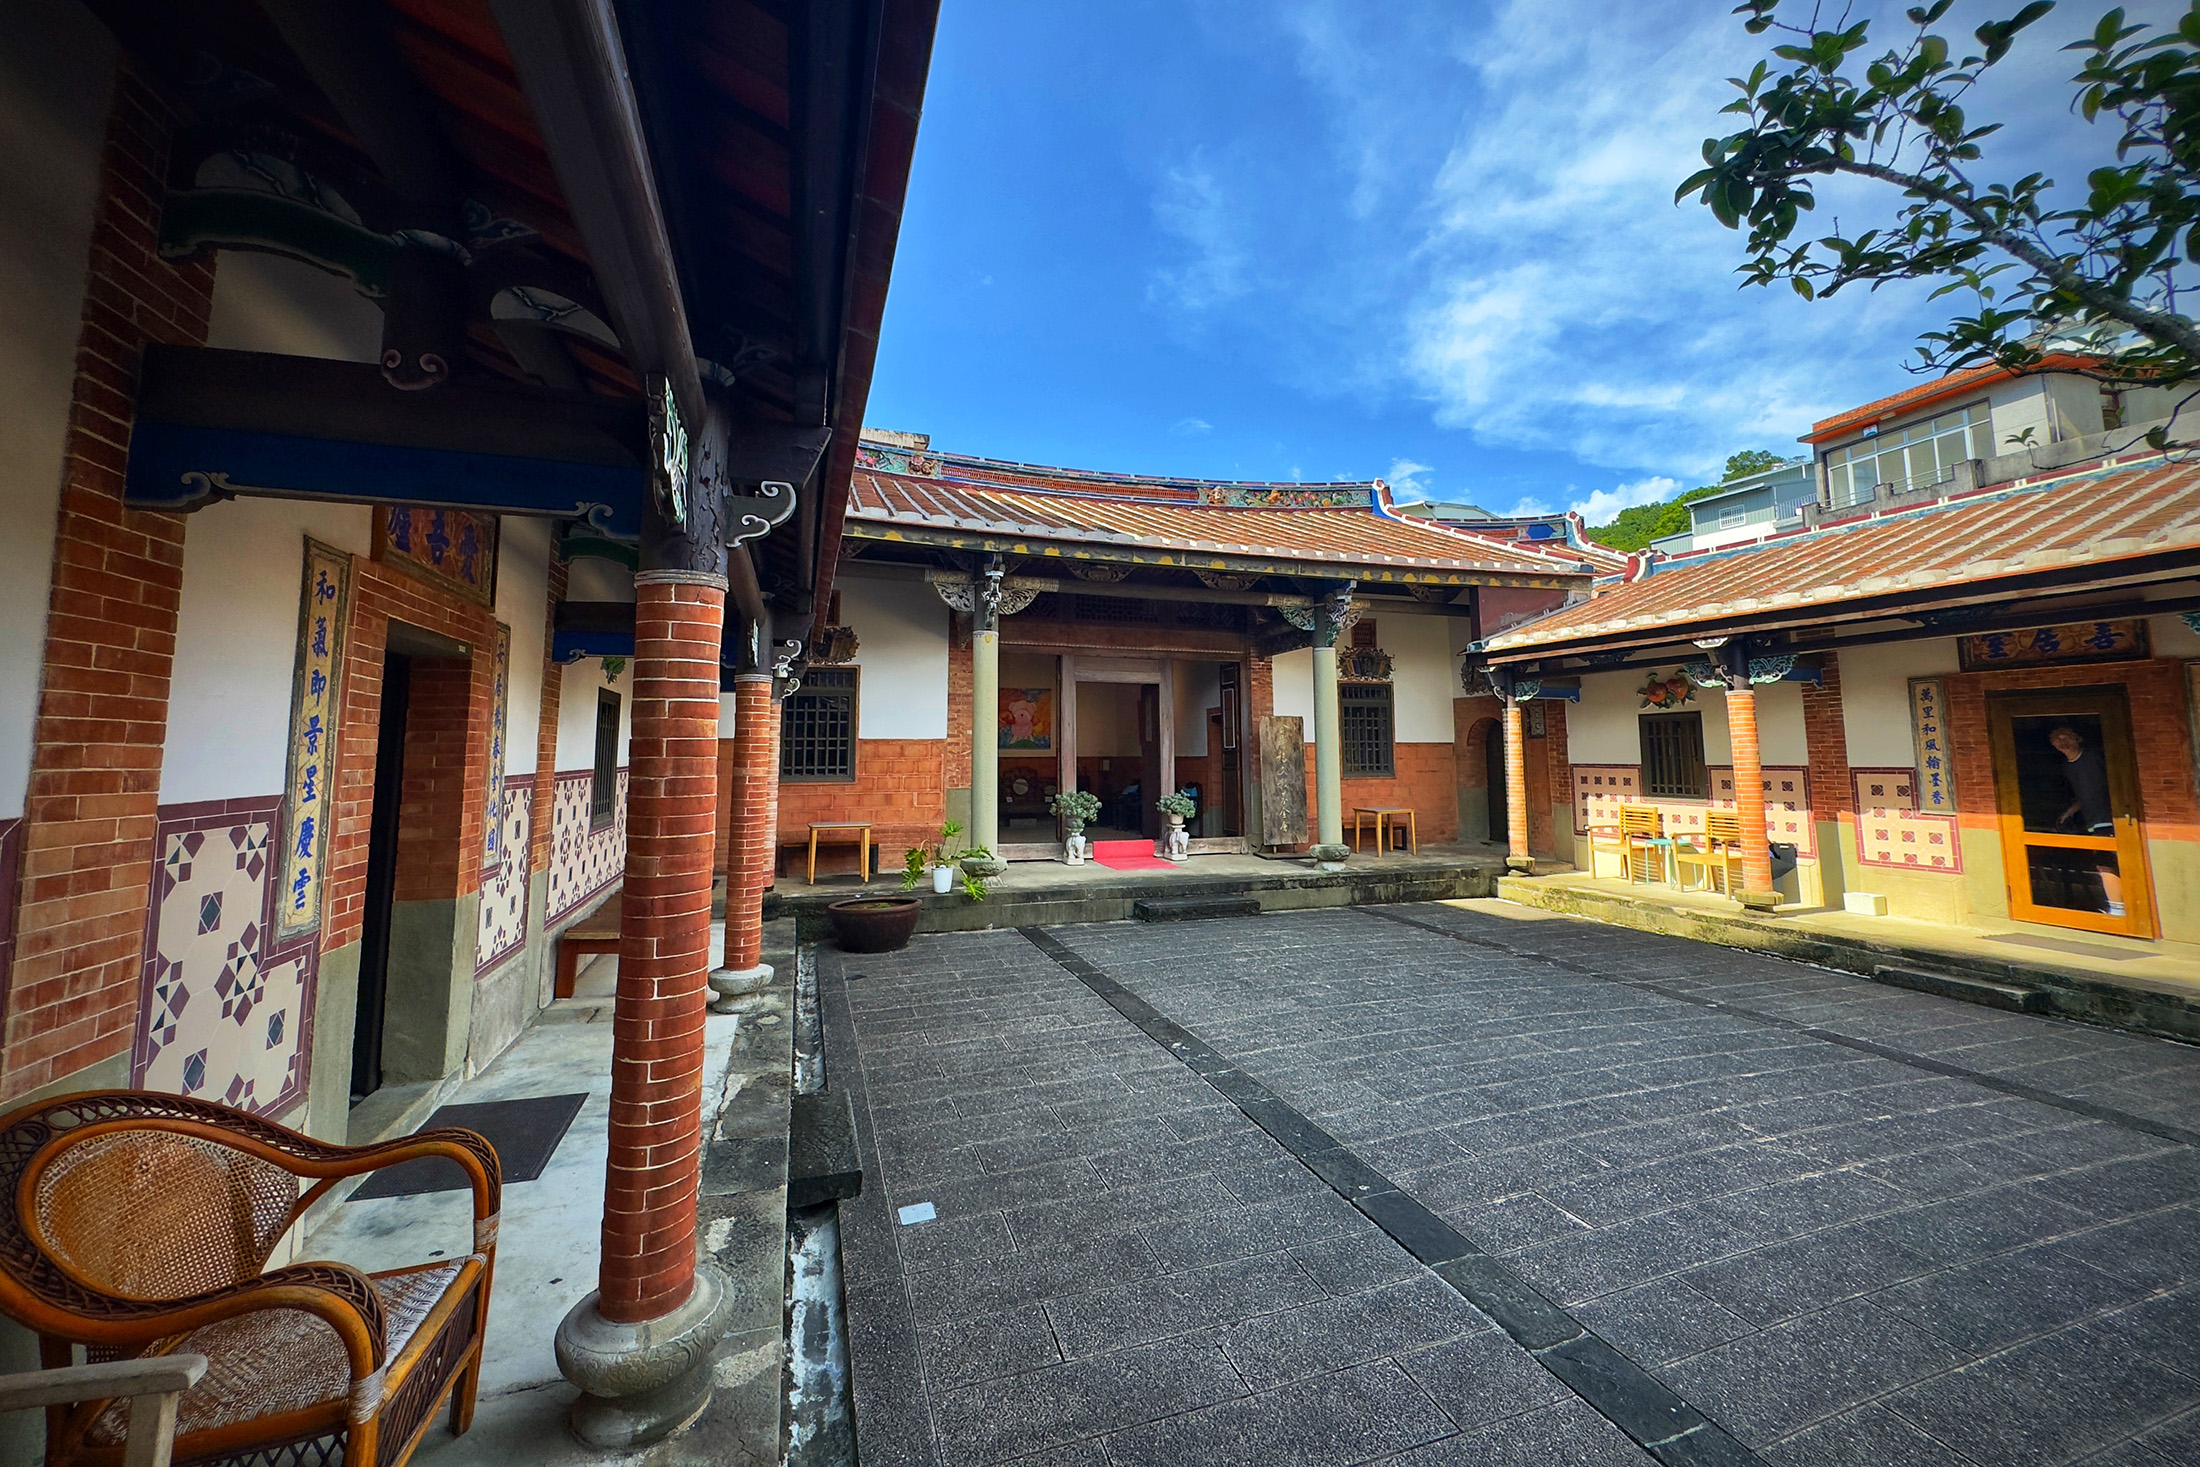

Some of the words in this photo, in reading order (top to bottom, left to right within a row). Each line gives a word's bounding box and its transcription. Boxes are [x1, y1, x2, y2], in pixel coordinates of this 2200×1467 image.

[1920, 687, 1945, 805] 萬里和風翰墨香
